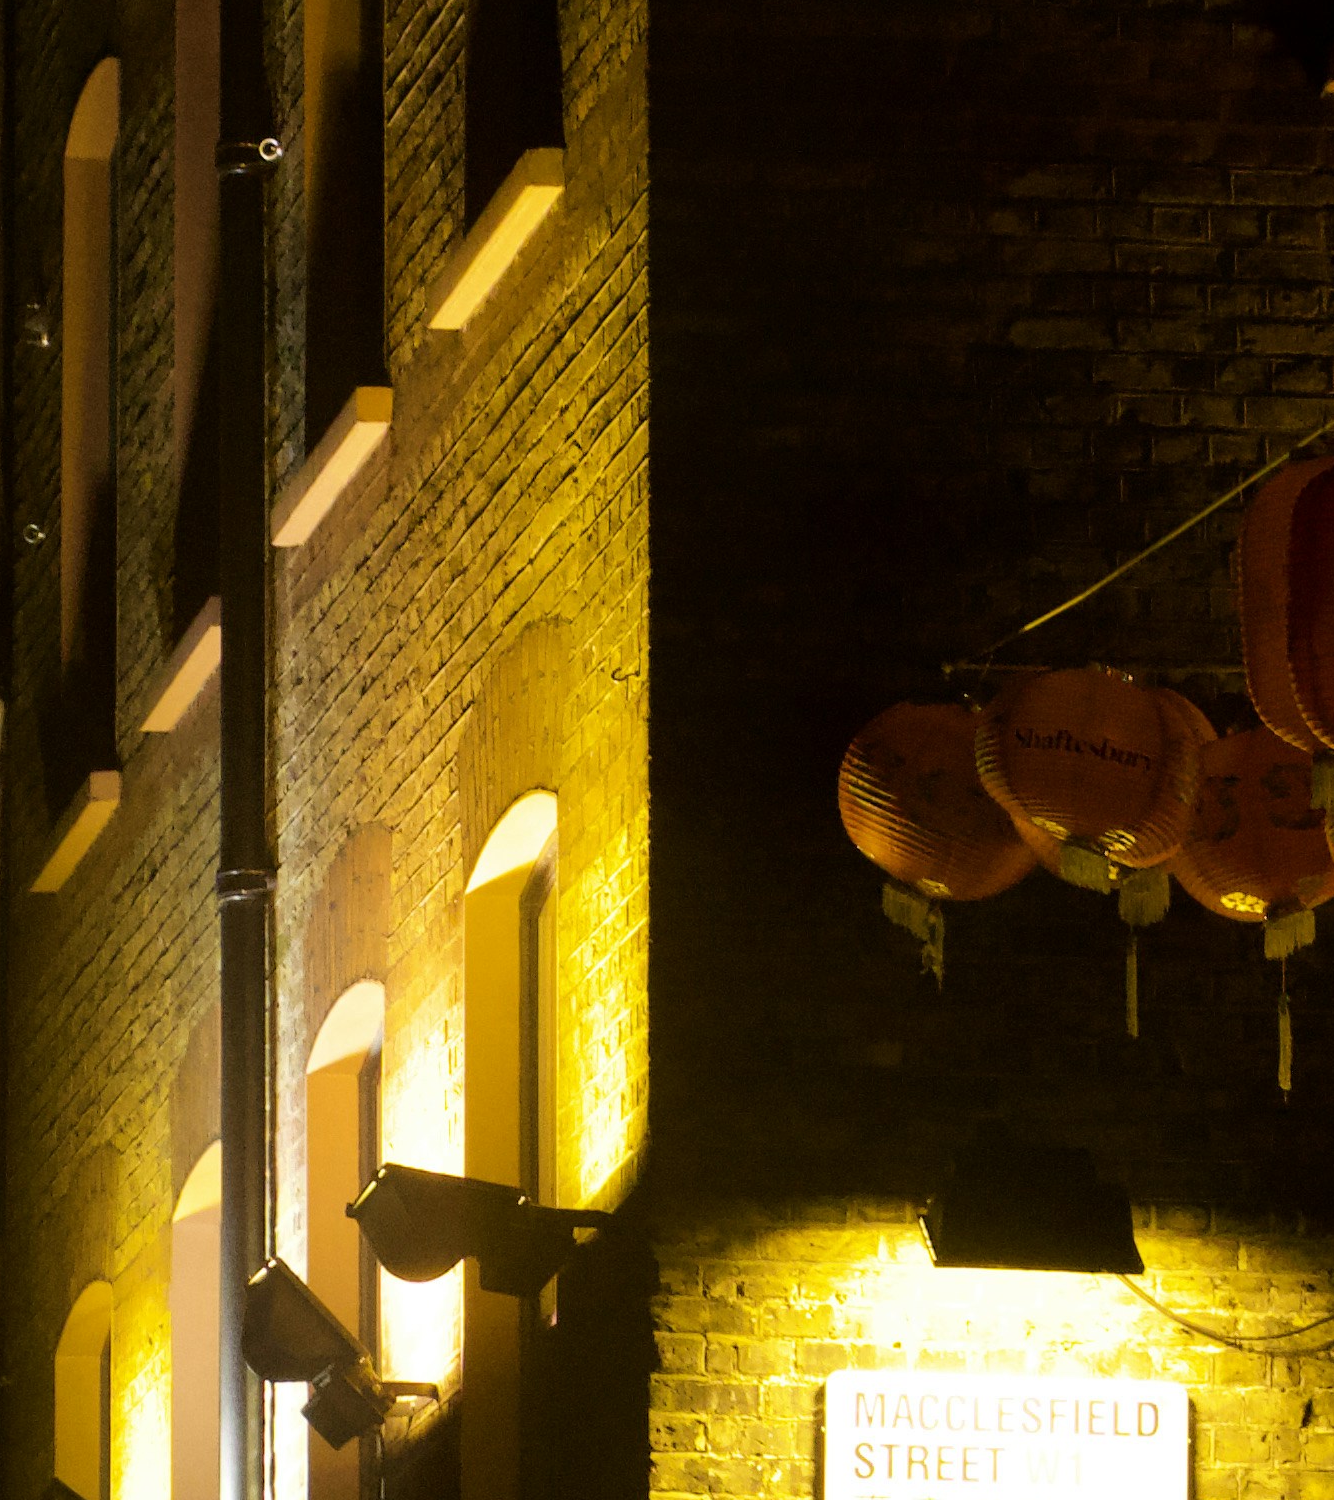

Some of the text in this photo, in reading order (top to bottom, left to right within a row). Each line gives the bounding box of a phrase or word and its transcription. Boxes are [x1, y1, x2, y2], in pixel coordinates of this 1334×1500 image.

[854, 1391, 1160, 1438] MACCLESFIELD
[854, 1442, 1082, 1486] STREET W1
